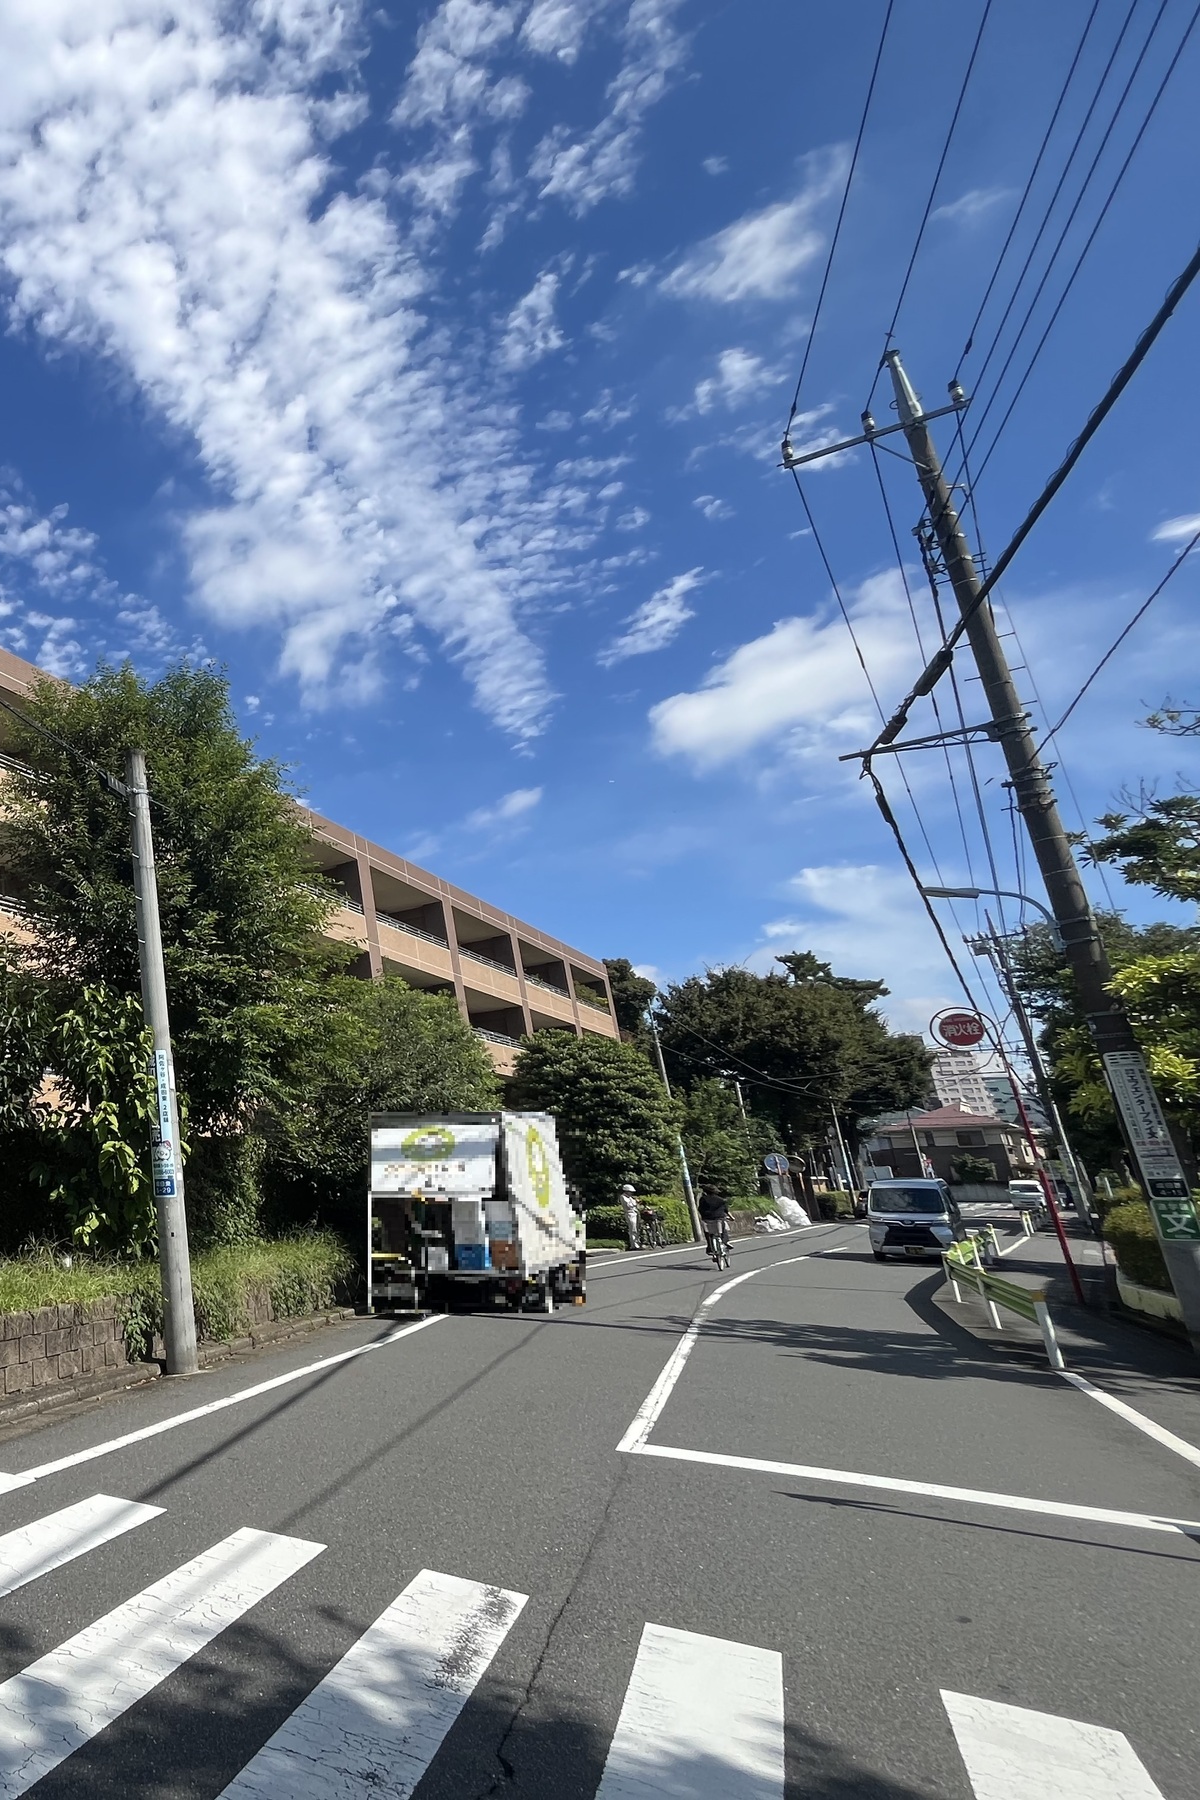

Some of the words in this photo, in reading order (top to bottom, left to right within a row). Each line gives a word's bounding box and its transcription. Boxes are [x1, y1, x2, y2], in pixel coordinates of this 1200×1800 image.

[942, 1022, 981, 1037] 消火栓
[1160, 1211, 1197, 1233] 文
